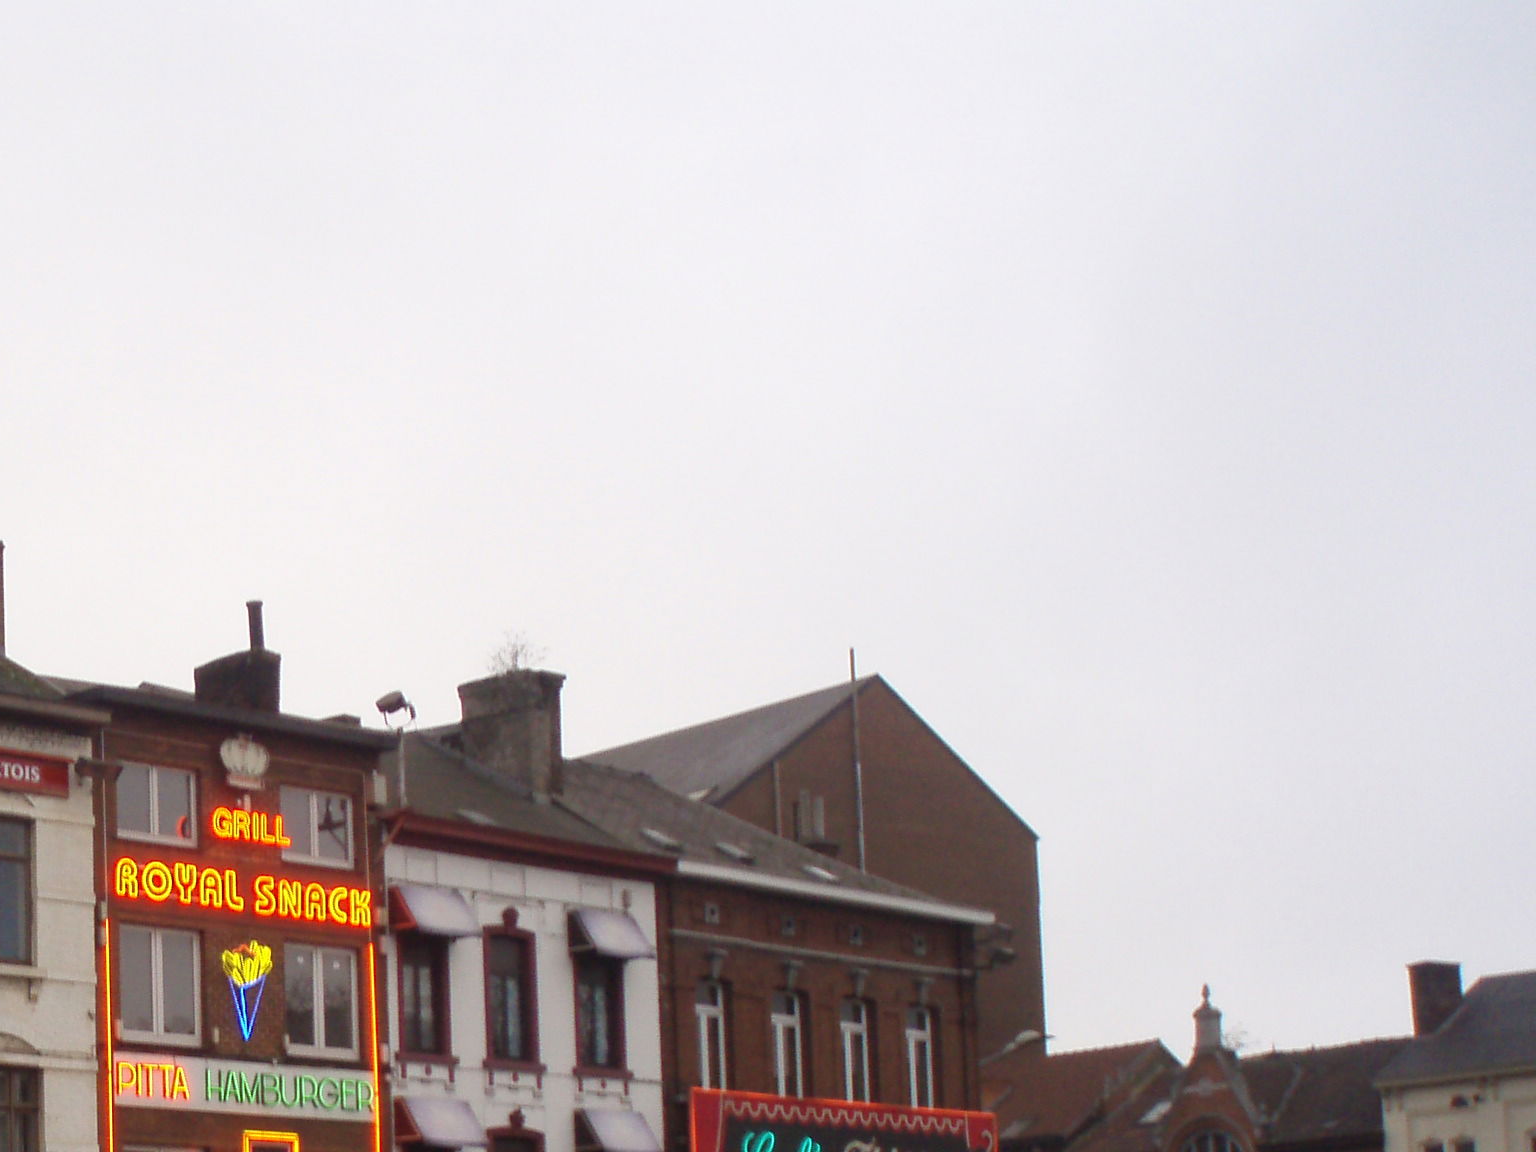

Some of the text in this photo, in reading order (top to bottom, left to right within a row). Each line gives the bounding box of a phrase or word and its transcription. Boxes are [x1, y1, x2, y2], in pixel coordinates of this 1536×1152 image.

[212, 807, 291, 847] GRILL
[115, 856, 372, 928] ROYAL SNACK
[116, 1061, 373, 1113] PITTA HAMBURGER
